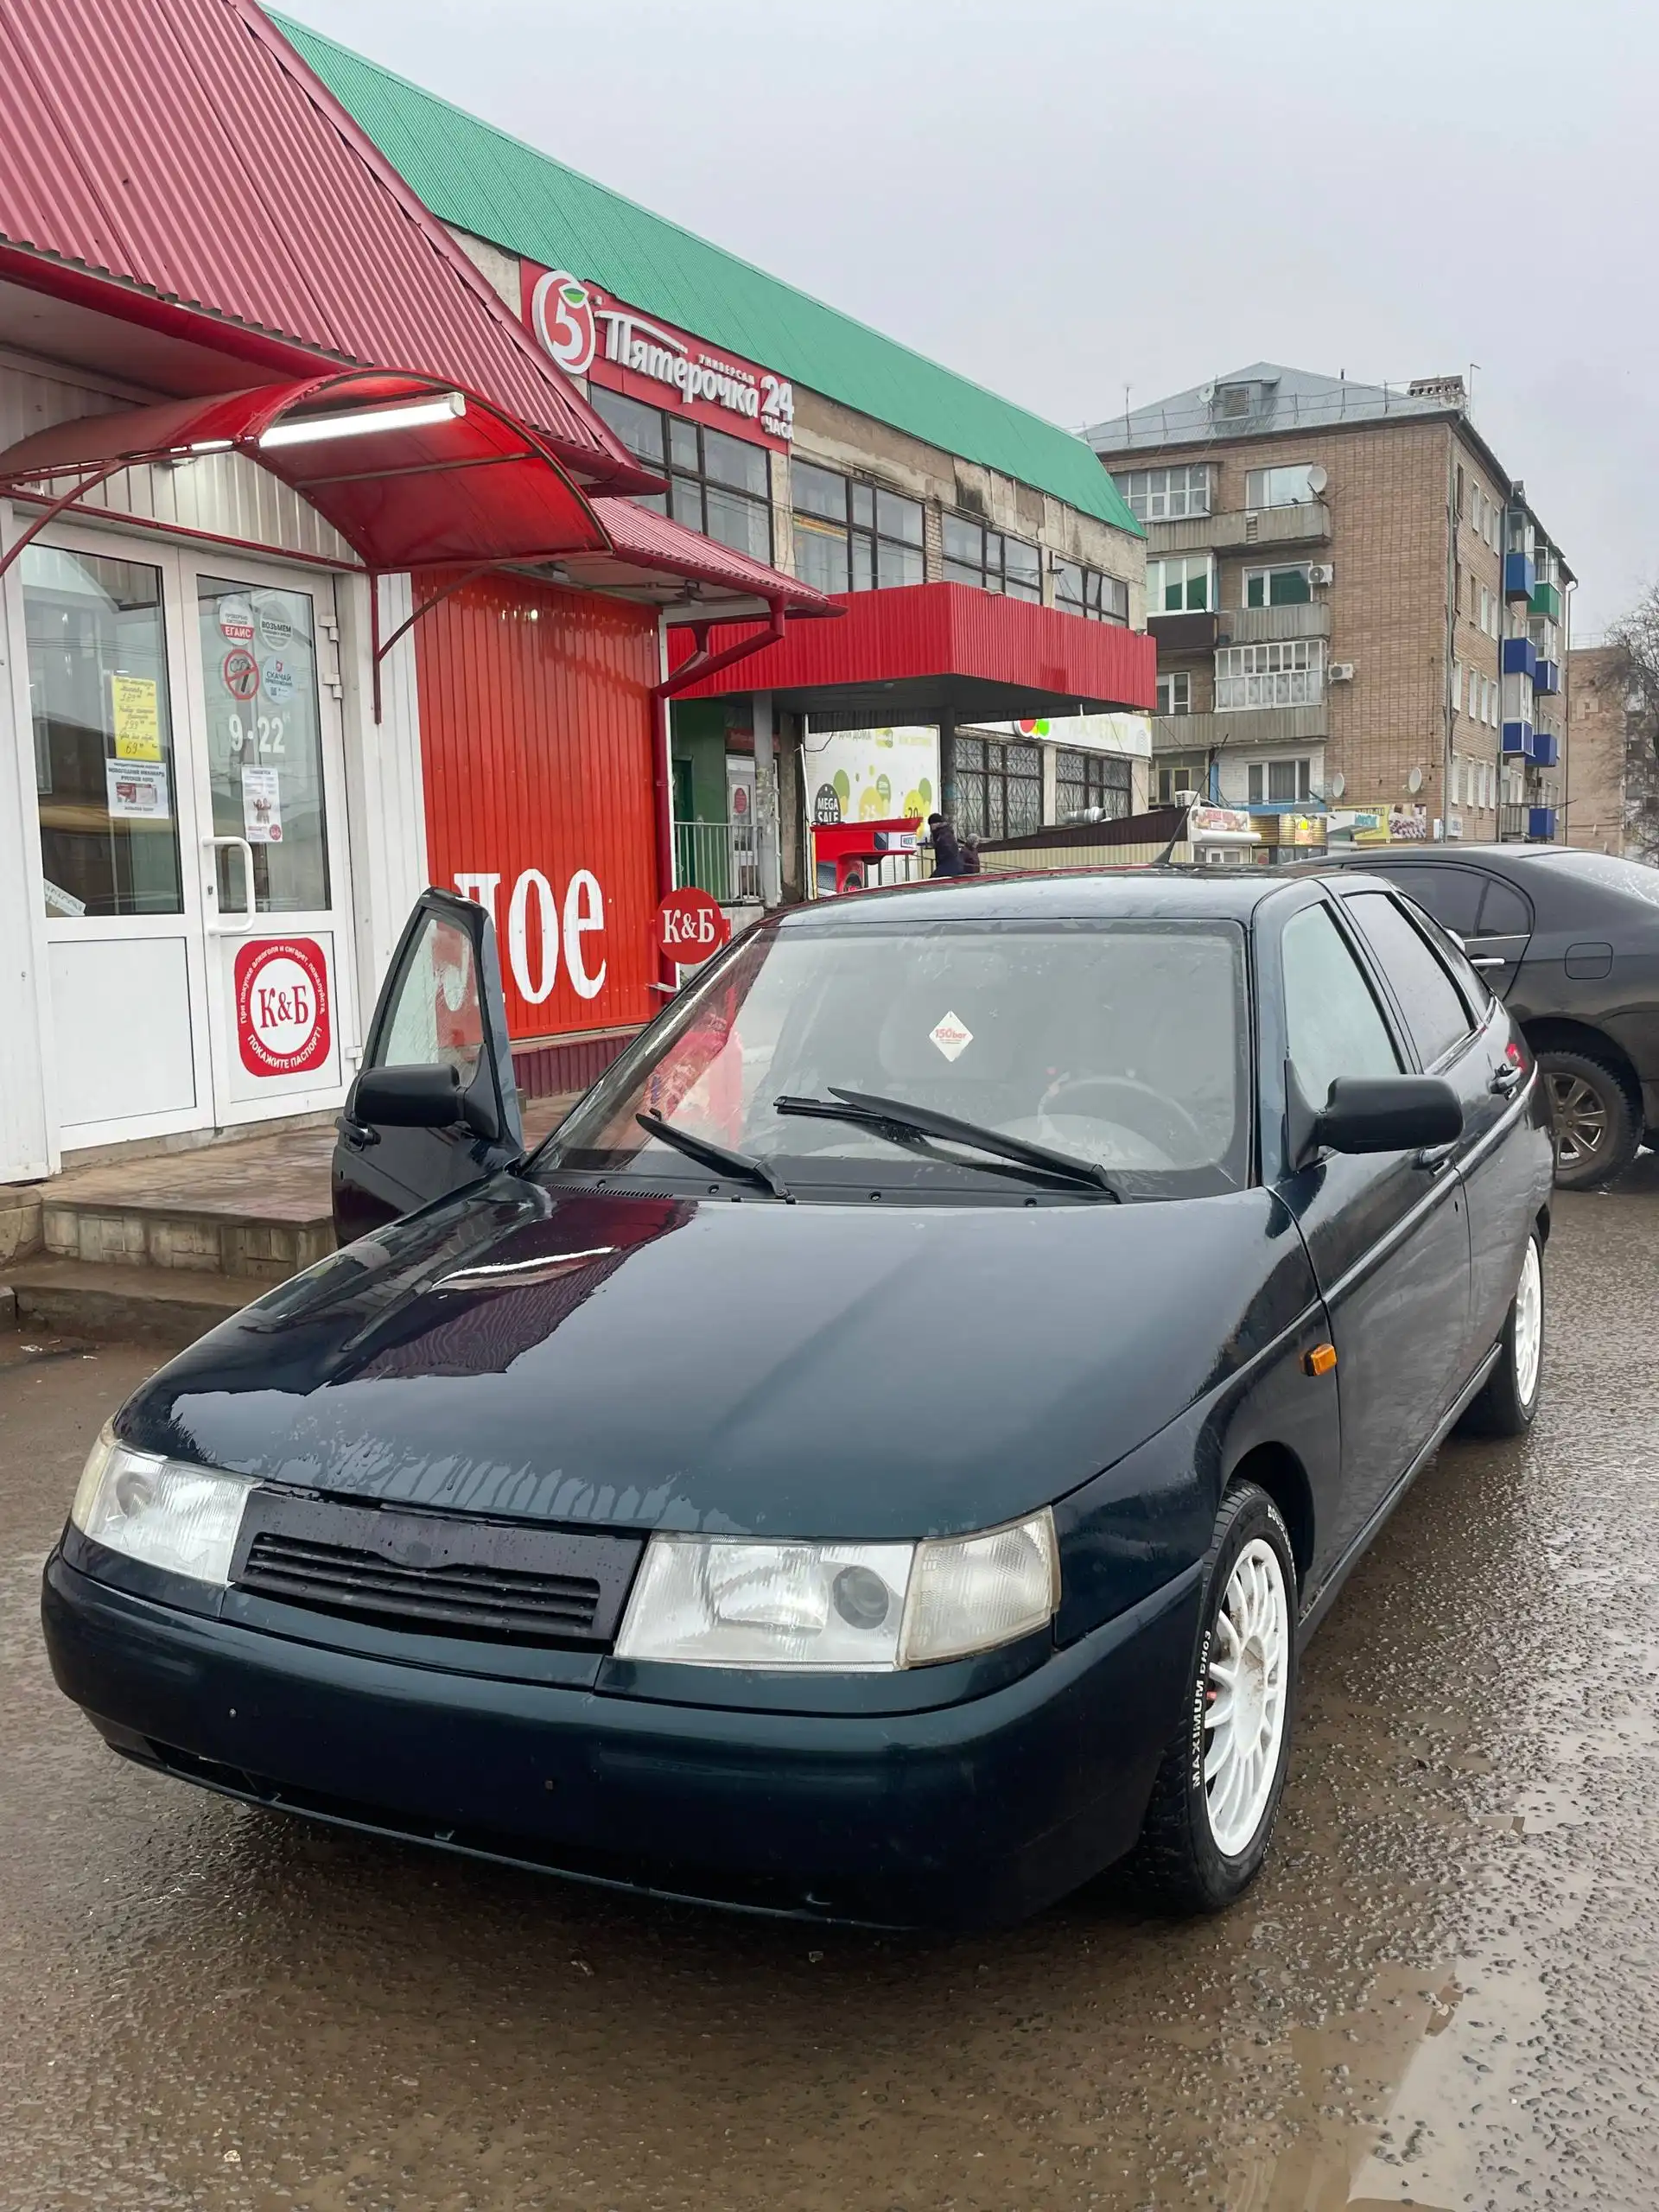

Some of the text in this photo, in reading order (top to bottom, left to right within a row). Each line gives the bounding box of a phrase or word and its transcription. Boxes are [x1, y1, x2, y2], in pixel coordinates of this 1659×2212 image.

[760, 375, 793, 422] 24
[762, 416, 794, 441] ЧАСА
[225, 626, 251, 638] ЕГАИС
[262, 620, 291, 632] ВОЗЬМЕМ
[266, 671, 292, 682] СКАЧАЙ
[817, 797, 839, 810] MEGA
[817, 812, 839, 823] SALE
[662, 908, 715, 944] К&Б
[251, 945, 279, 969] алкоголя
[257, 985, 308, 1029] К&Б
[247, 1025, 324, 1069] ПОКАЖИТЕ ПАСПОРТ!
[1191, 1679, 1205, 1790] MAXIMUM
